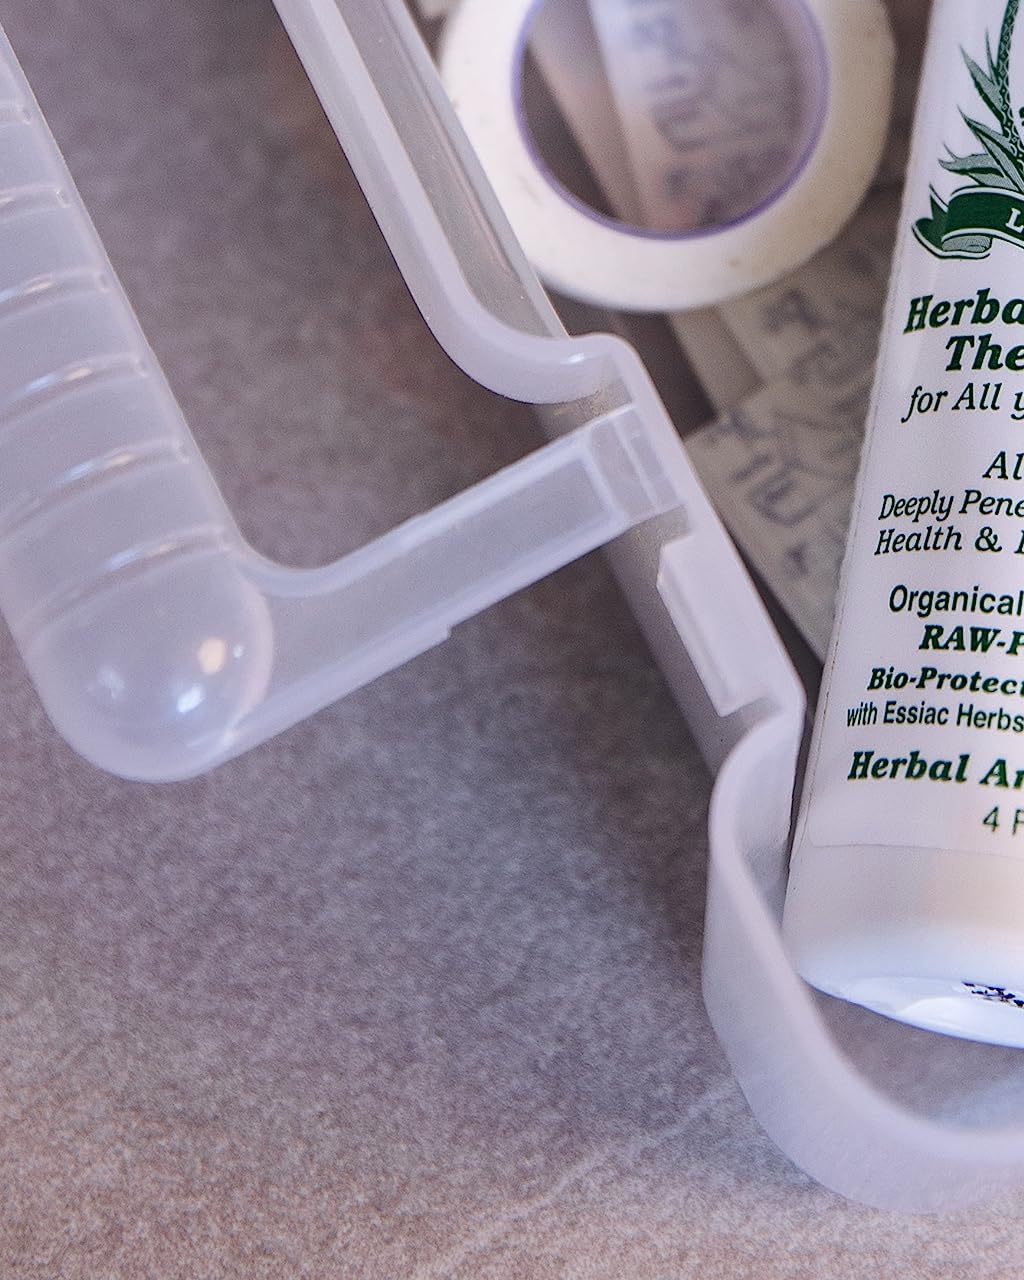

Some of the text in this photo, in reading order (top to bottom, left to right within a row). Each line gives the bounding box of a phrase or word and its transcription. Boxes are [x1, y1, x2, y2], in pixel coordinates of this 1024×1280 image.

[901, 385, 948, 423] for
[951, 382, 1002, 411] All
[878, 489, 954, 523] Deeply
[874, 525, 962, 556] Health
[974, 526, 1002, 553] &
[847, 701, 878, 727] with
[883, 700, 949, 726] Essiac
[956, 702, 1024, 733] Herbs
[847, 750, 970, 783] Herbal
[982, 806, 1000, 832] 4
